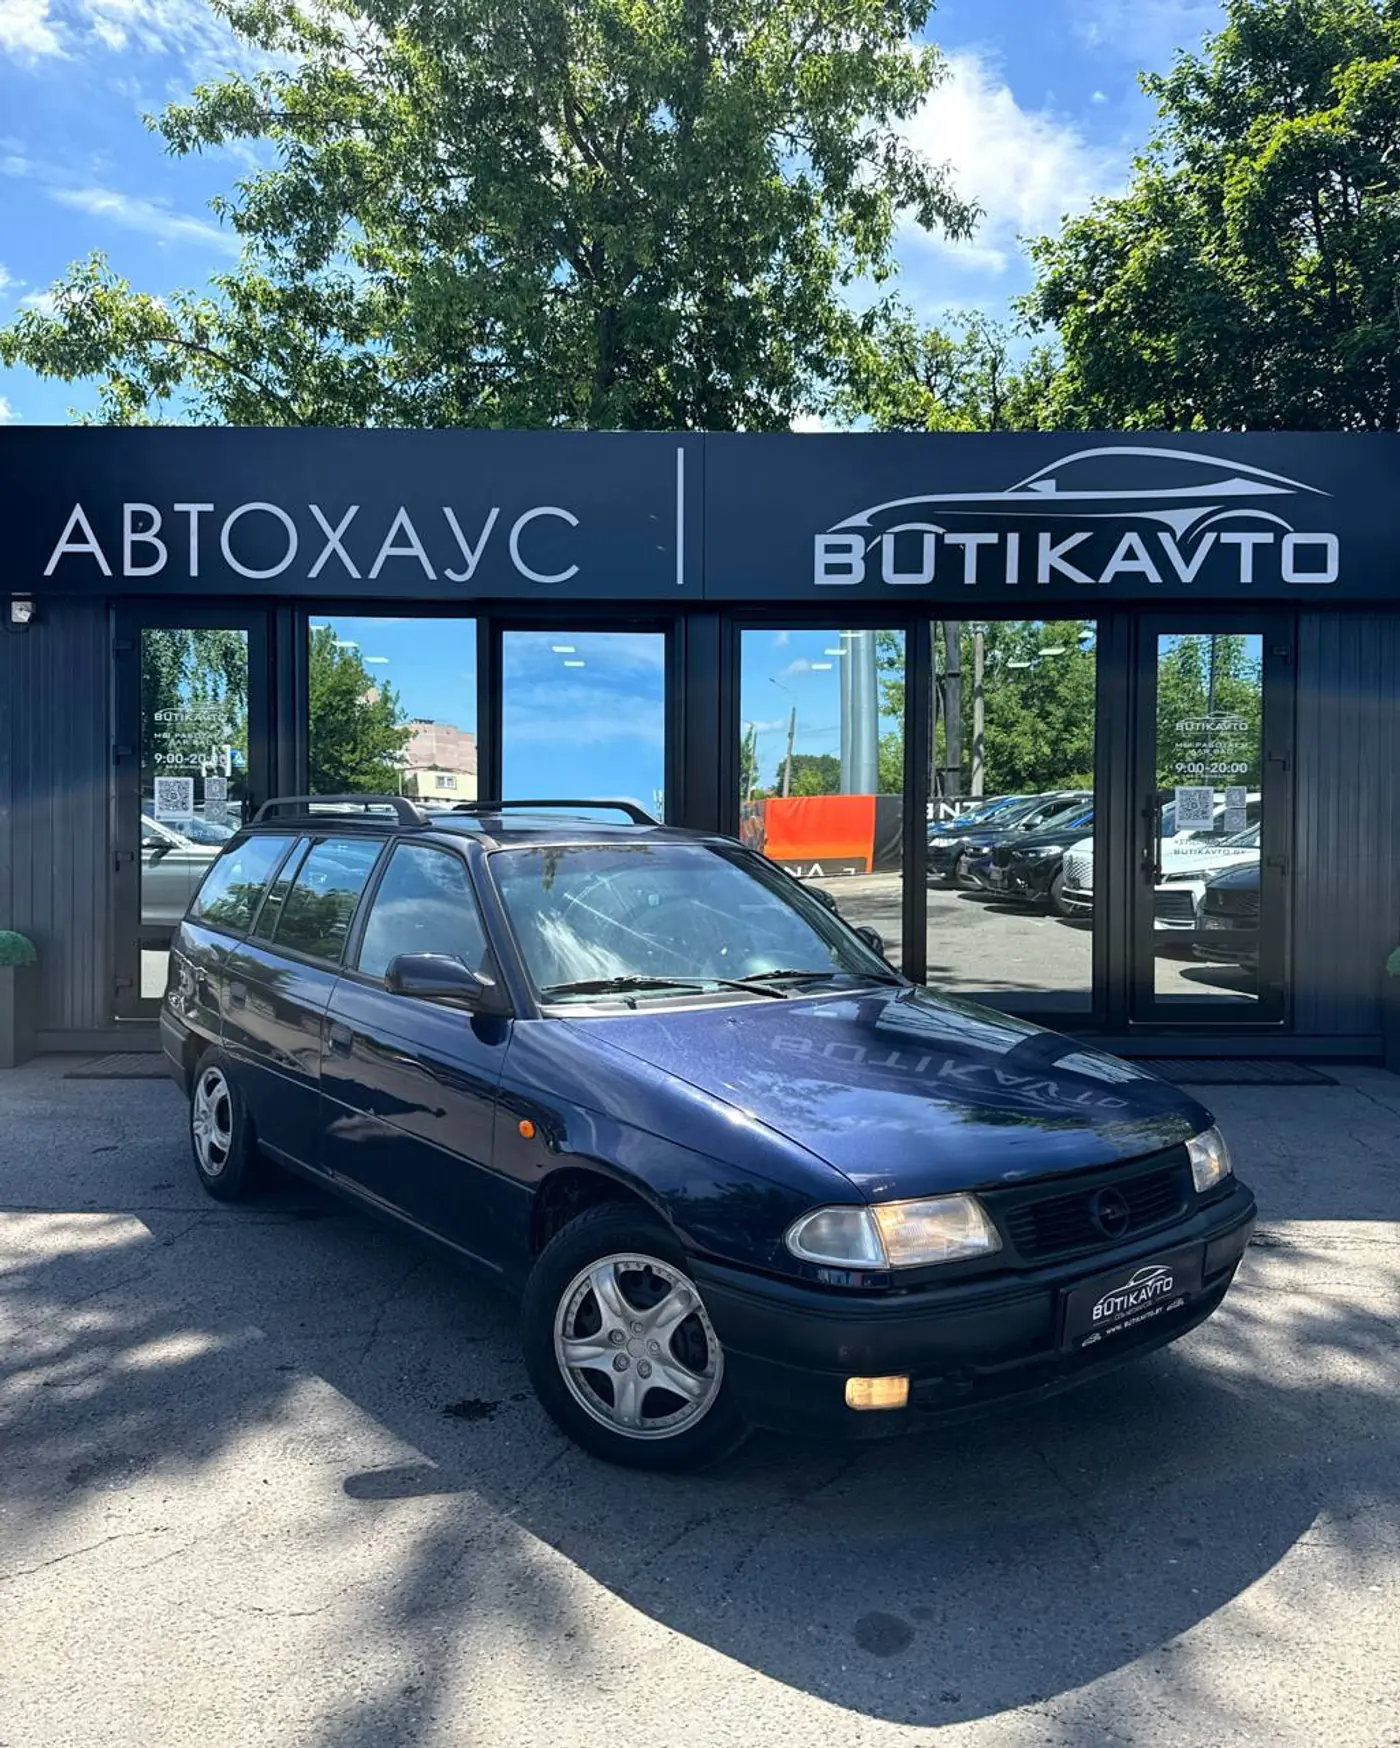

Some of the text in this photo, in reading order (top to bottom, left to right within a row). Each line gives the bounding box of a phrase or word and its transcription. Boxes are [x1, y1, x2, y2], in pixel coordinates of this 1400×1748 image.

[43, 501, 579, 585] АВТОХАУС
[813, 531, 1340, 585] BUTIKAVTO
[1175, 722, 1248, 731] BUTIKAVTO
[1175, 762, 1248, 773] 9:00-20:00
[1092, 1277, 1173, 1321] BUTIKAVTO
